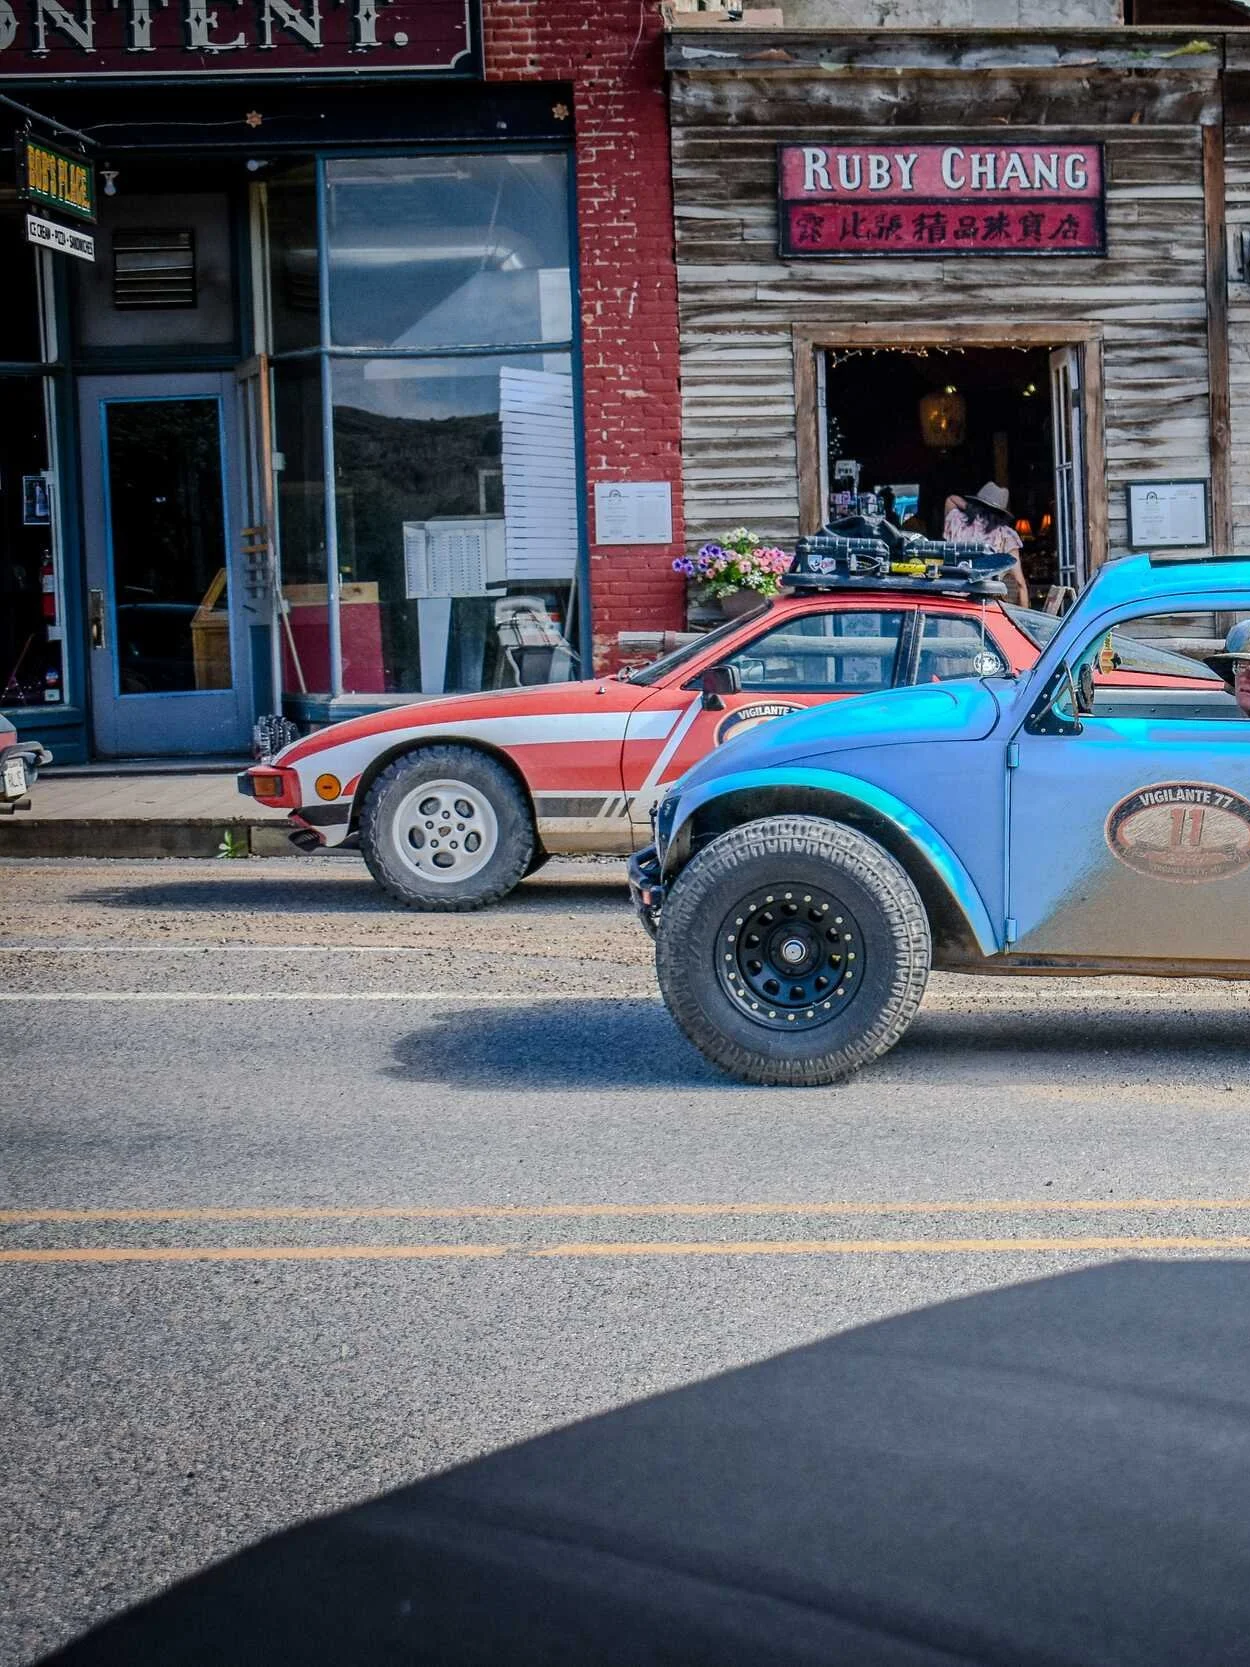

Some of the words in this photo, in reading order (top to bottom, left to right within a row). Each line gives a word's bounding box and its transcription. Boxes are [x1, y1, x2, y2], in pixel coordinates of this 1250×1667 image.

[0, 0, 409, 53] NTENT.
[738, 705, 790, 720] VIGILANTE
[1139, 788, 1212, 807] VIGILANTE
[1215, 793, 1235, 809] 77
[1170, 807, 1206, 847] 11
